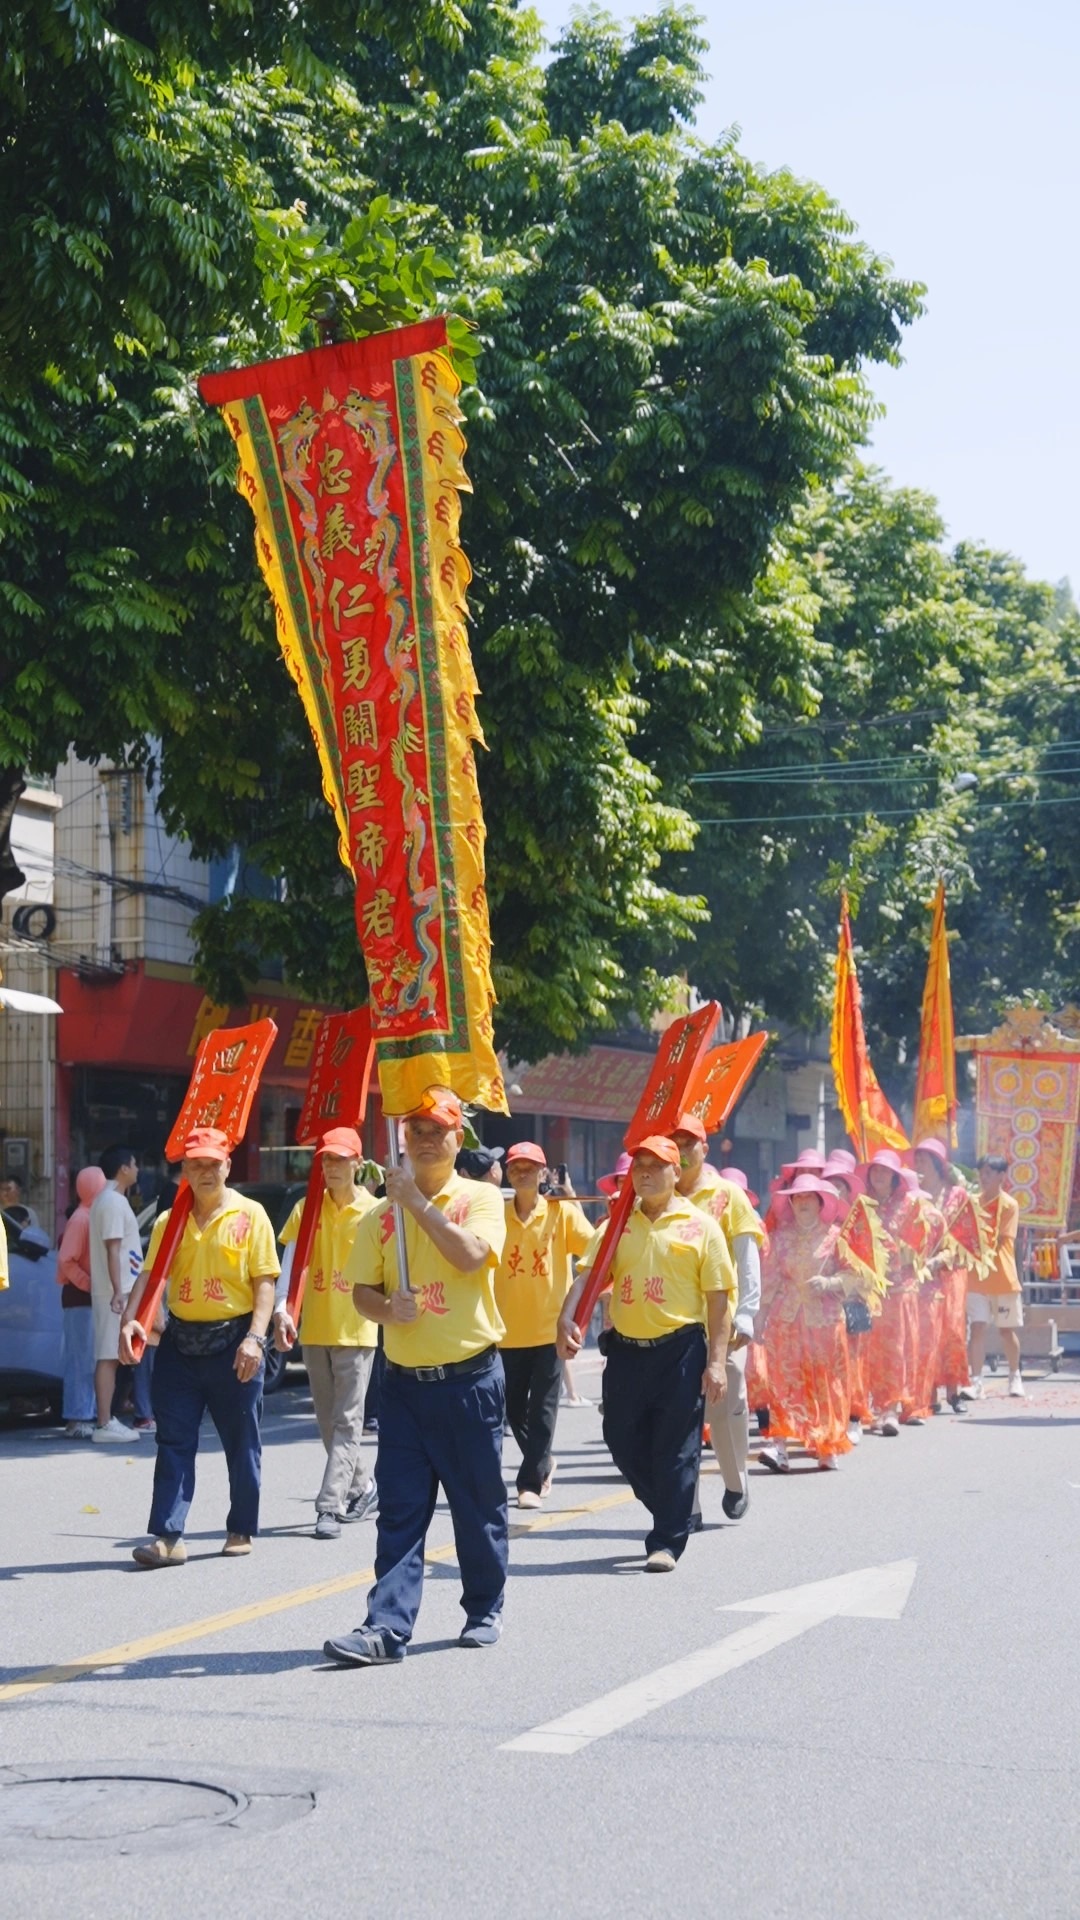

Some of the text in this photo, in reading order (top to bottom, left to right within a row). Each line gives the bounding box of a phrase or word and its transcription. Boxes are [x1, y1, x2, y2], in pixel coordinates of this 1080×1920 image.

[318, 446, 397, 940] 忠義仁勇關聖帝君
